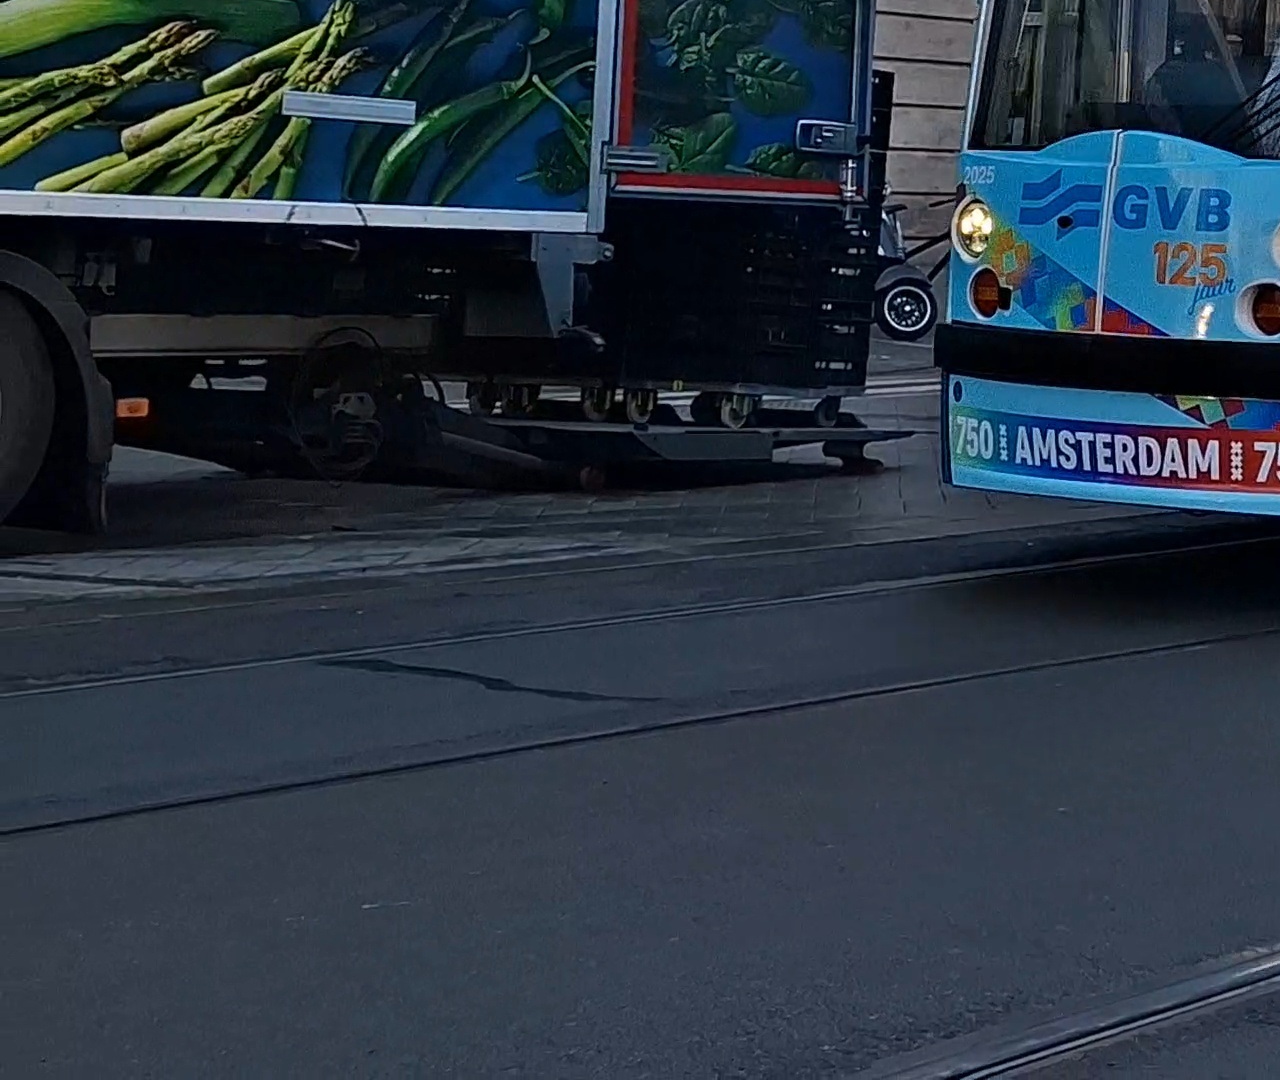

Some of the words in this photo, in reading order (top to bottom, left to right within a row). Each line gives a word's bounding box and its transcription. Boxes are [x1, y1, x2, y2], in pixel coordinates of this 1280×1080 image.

[964, 165, 995, 185] 2025
[1112, 184, 1232, 233] GVB
[1153, 241, 1228, 287] 125
[955, 417, 994, 460] 750
[1015, 425, 1220, 481] AMSTERDAM
